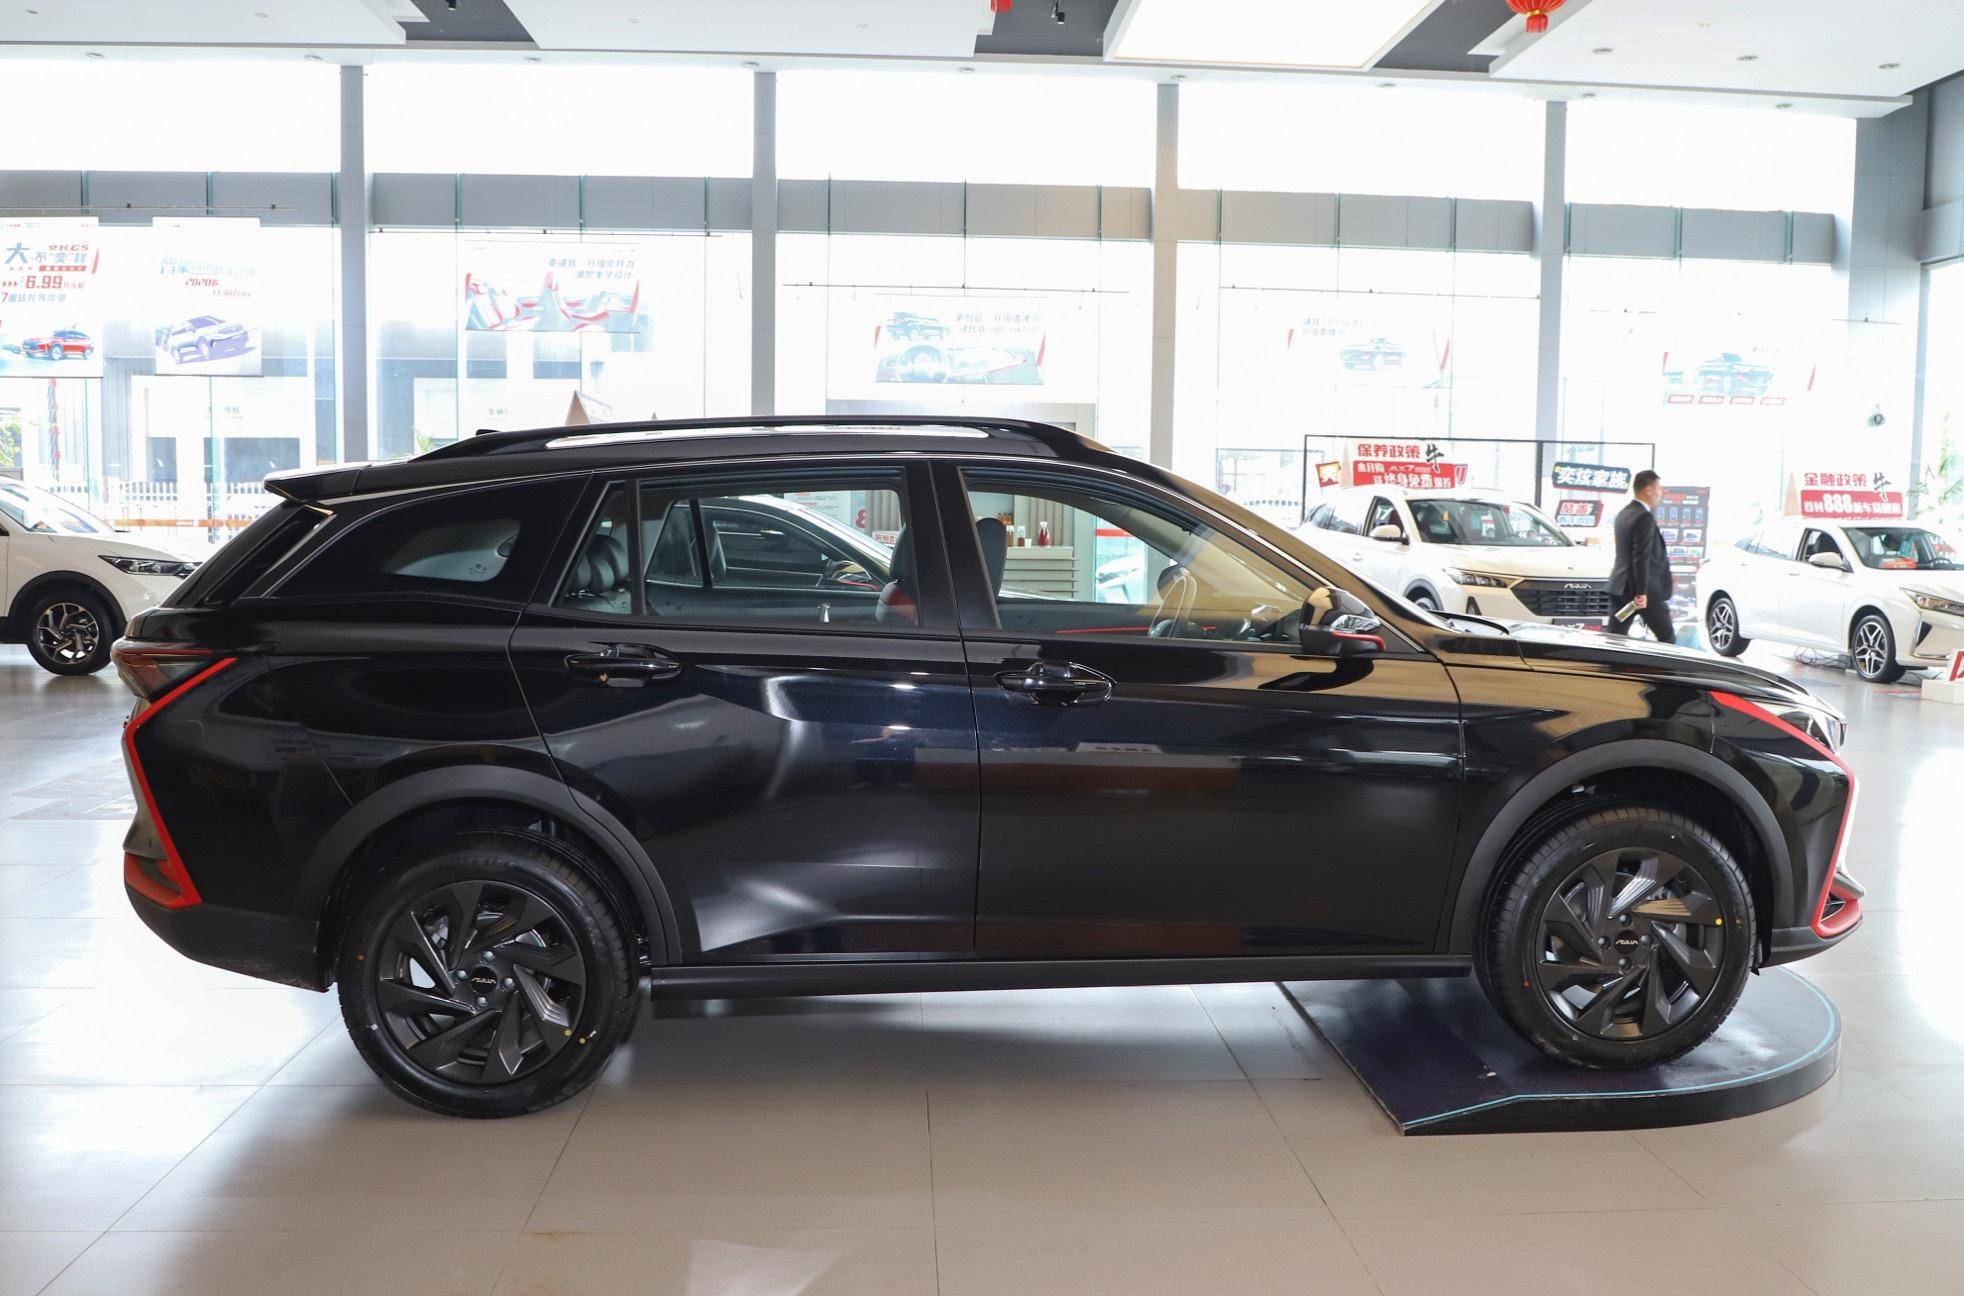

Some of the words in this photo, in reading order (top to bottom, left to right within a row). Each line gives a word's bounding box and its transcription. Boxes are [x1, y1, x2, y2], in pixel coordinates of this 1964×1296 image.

[1357, 443, 1421, 459] 保养政策
[1804, 472, 1867, 487] 金融政策
